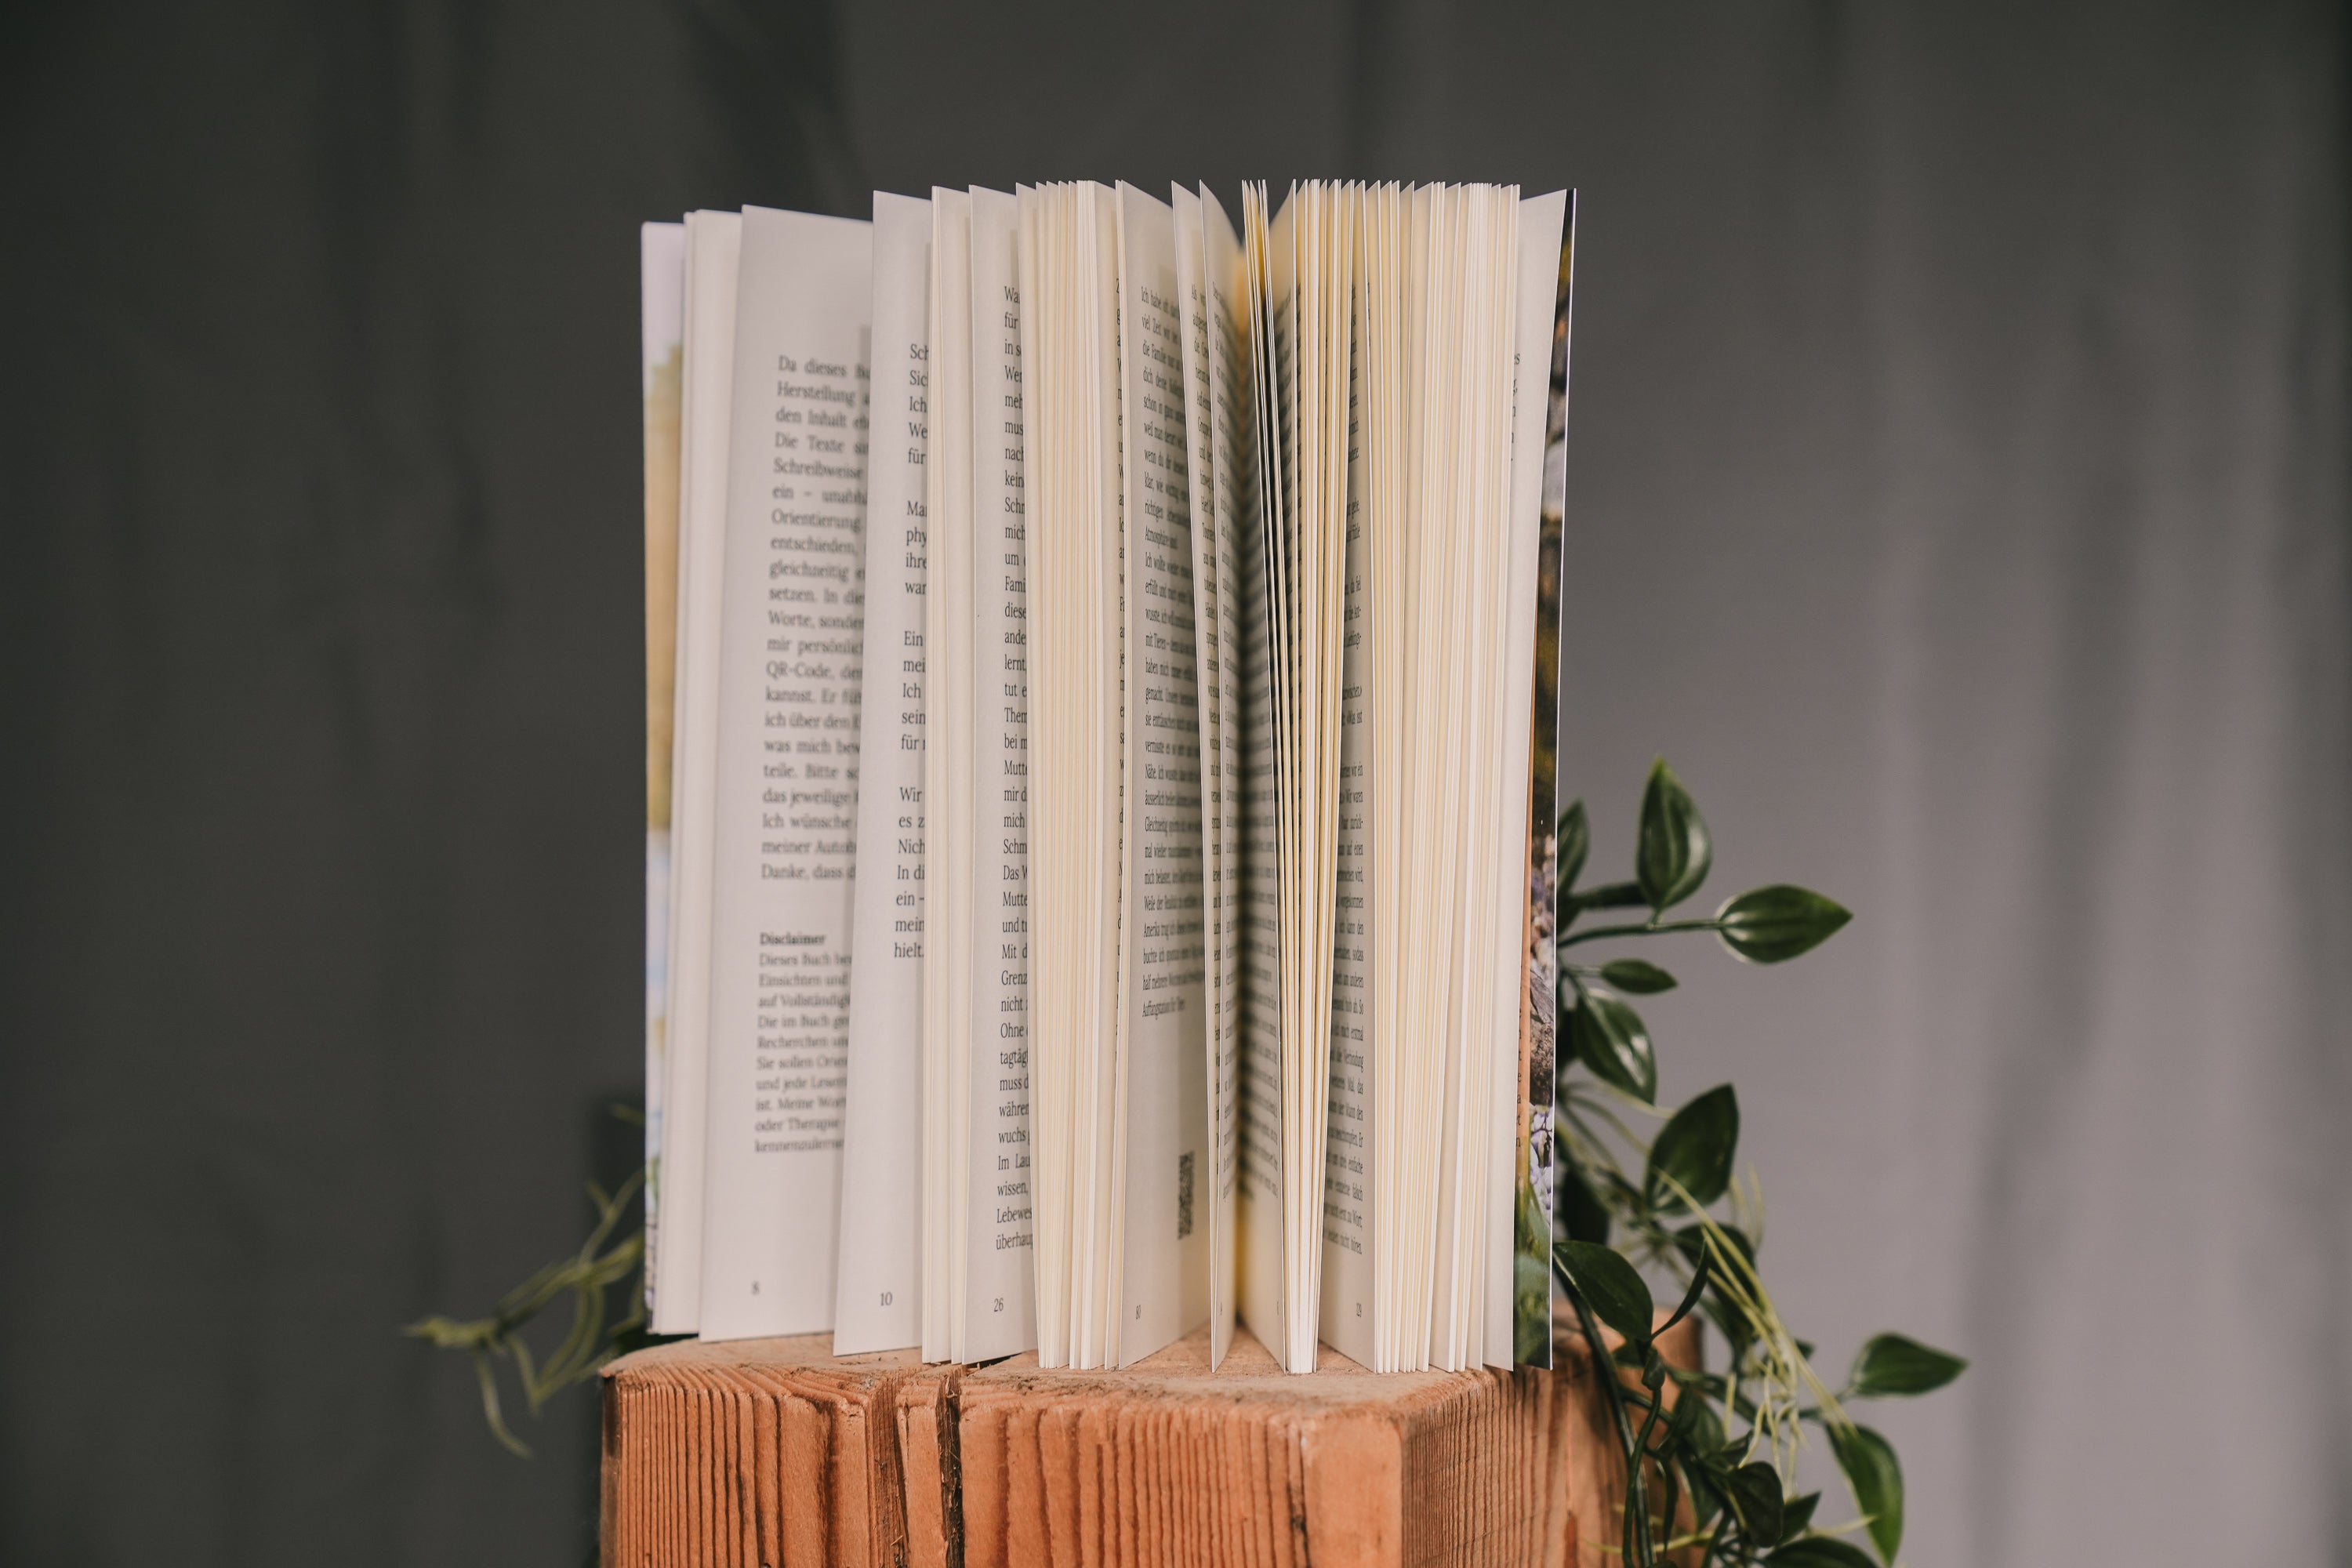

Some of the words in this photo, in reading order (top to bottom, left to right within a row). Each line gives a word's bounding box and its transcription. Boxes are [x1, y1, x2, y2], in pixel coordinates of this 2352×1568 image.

[1150, 289, 1161, 310] habe
[1004, 311, 1018, 329] für
[1142, 314, 1150, 332] viel
[1152, 318, 1162, 336] Zeit
[1005, 339, 1013, 355] in
[1152, 343, 1167, 365] Familie
[779, 355, 797, 373] Da
[804, 359, 847, 377] dieses
[1143, 365, 1153, 385] dich
[777, 380, 855, 408] Herstellung
[909, 396, 927, 413] Ich
[1144, 394, 1157, 413] schon
[1159, 398, 1163, 415] in
[775, 407, 801, 423] den
[808, 409, 847, 427] Inhalt
[909, 422, 927, 439] We
[1144, 422, 1153, 437] weil
[1154, 426, 1163, 441] man
[775, 431, 797, 449] Die
[808, 434, 845, 453] Texte
[908, 447, 926, 464] für
[1145, 449, 1156, 465] wenn
[774, 457, 862, 479] Schreibweise
[1145, 470, 1155, 492] klar,
[772, 483, 793, 499] ein
[1145, 499, 1163, 523] richtigen
[771, 509, 861, 534] Orientierung
[906, 527, 927, 548] phy
[1005, 524, 1025, 541] mich
[1145, 525, 1169, 550] Atmosphäre
[771, 535, 858, 556] entschieden,
[906, 552, 927, 569] ihre
[1005, 553, 1019, 566] um
[769, 559, 849, 583] gleichzeitig
[905, 582, 927, 595] war
[1145, 579, 1159, 596] erfüllt
[824, 589, 837, 604] In
[1005, 602, 1026, 619] diese
[768, 610, 815, 629] Worte,
[768, 636, 789, 652] mir
[904, 630, 924, 647] Ein
[1154, 633, 1167, 650] Tieren
[766, 661, 834, 680] QR-Code,
[903, 658, 926, 673] mei
[1145, 657, 1159, 675] haben
[822, 688, 837, 704] Er
[903, 683, 921, 699] Ich
[1004, 683, 1017, 696] tut
[765, 712, 786, 728] ich
[789, 713, 820, 728] über
[824, 713, 850, 730] den
[902, 710, 926, 724] sein
[1004, 706, 1027, 724] Them
[764, 740, 791, 753] was
[797, 739, 831, 754] mich
[902, 734, 919, 750] für
[1004, 732, 1017, 750] bei
[805, 763, 838, 780] Bitte
[763, 787, 786, 804] das
[789, 788, 850, 808] jeweilige
[900, 786, 922, 802] Wir
[1004, 786, 1019, 801] mir
[1353, 791, 1363, 804] waren
[763, 813, 785, 829] Ich
[789, 814, 850, 829] wünsche
[899, 816, 912, 828] es
[1004, 811, 1025, 828] mich
[1145, 816, 1167, 837] Gleichzeitig
[762, 839, 811, 855] meiner
[898, 839, 925, 855] Nich
[1354, 841, 1363, 856] einen
[761, 863, 809, 880] Danke,
[812, 864, 842, 880] dass
[898, 864, 909, 880] In
[1004, 865, 1019, 880] Das
[1145, 869, 1155, 884] mich
[896, 891, 915, 906] ein
[1003, 891, 1027, 906] Mutte
[895, 916, 924, 932] mein
[1002, 916, 1018, 933] und
[1144, 922, 1160, 938] Amerika
[760, 931, 826, 946] Disclaimer
[895, 942, 924, 959] hielt.
[1002, 944, 1016, 960] Mit
[1143, 948, 1157, 964] buchte
[1352, 946, 1363, 962] sodass
[759, 953, 798, 967] Dieses
[802, 953, 830, 965] Buch
[826, 972, 848, 986] und
[1001, 970, 1027, 985] Grenz
[1143, 974, 1152, 990] half
[1350, 974, 1363, 989] anderen
[758, 994, 777, 1008] auf
[1001, 996, 1022, 1012] nicht
[1359, 999, 1363, 1014] So
[757, 1015, 778, 1029] Die
[800, 1014, 829, 1028] Buch
[1000, 1022, 1023, 1038] Ohne
[1351, 1025, 1363, 1041] erstmal
[757, 1056, 774, 1070] Sie
[1345, 1049, 1363, 1073] Verbindung
[756, 1077, 779, 1091] und
[784, 1078, 806, 1094] jede
[1000, 1078, 1022, 1091] muss
[777, 1098, 813, 1112] Meine
[755, 1119, 782, 1133] oder
[999, 1127, 1025, 1143] wuchs
[1359, 1131, 1363, 1148] Er
[998, 1155, 1009, 1170] Im
[1348, 1156, 1363, 1175] einfache
[997, 1181, 1028, 1197] wissen,
[1352, 1181, 1363, 1202] falsch
[996, 1207, 1032, 1223] Lebewes
[1351, 1236, 1362, 1255] hören.
[880, 1292, 893, 1306] 10
[993, 1298, 1004, 1312] 26
